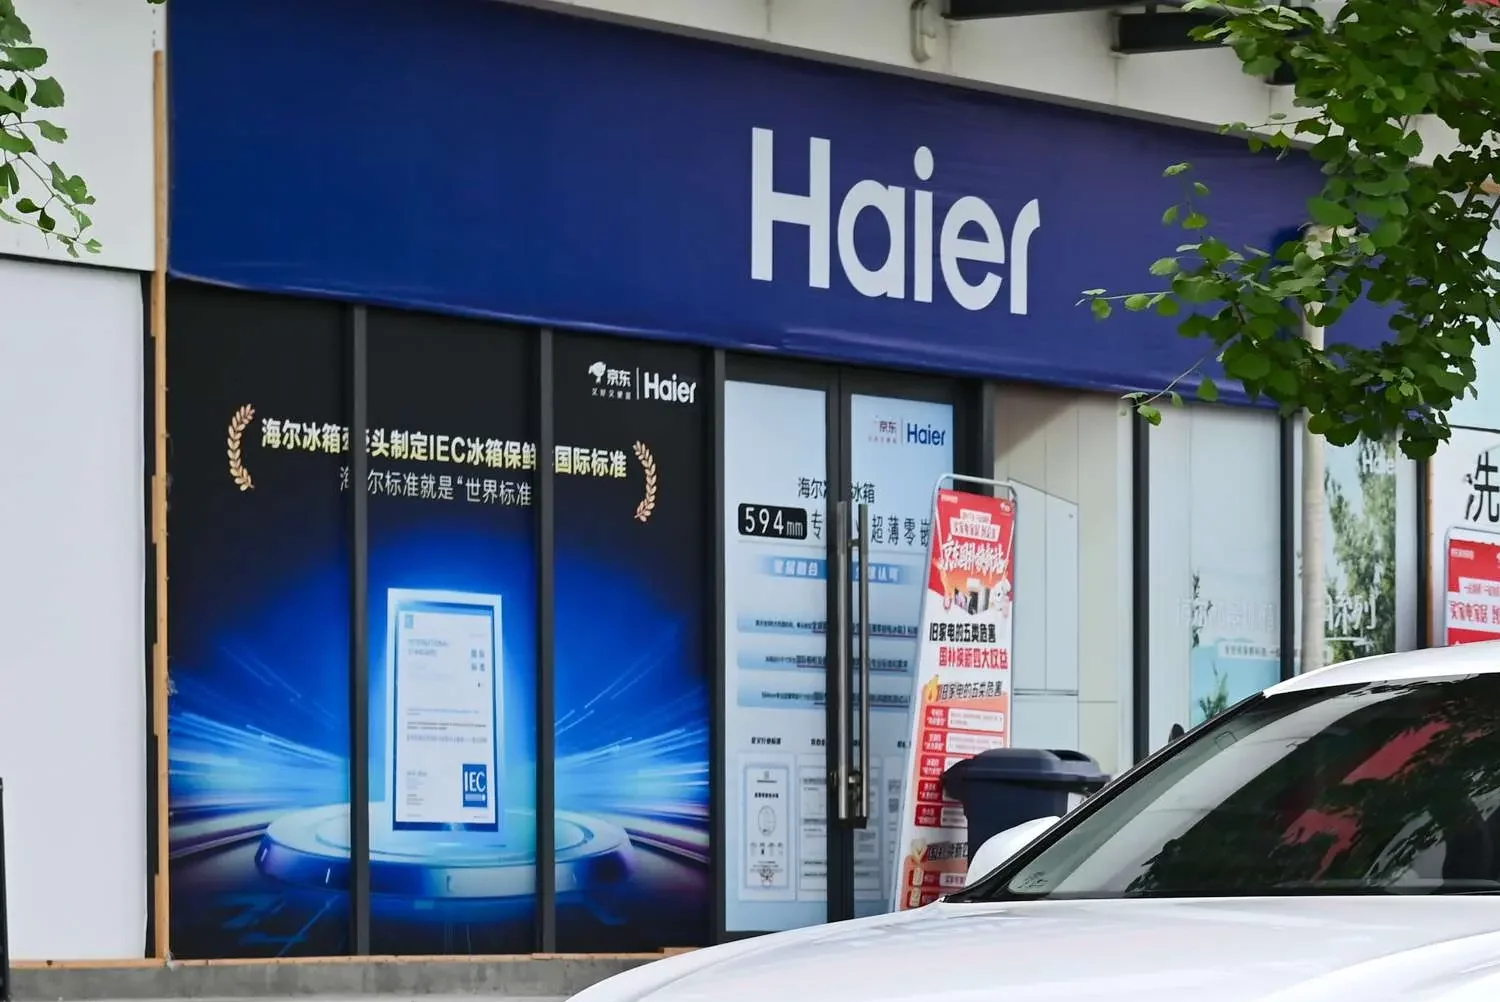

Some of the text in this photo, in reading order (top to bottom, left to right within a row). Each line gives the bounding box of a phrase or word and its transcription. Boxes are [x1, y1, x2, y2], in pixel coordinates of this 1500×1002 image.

[751, 127, 1040, 315] Haier
[607, 368, 631, 388] 京东
[644, 371, 697, 404] Haier
[907, 422, 946, 446] Haier
[929, 622, 997, 643] 旧家电的五类危害
[464, 770, 486, 794] IEC
